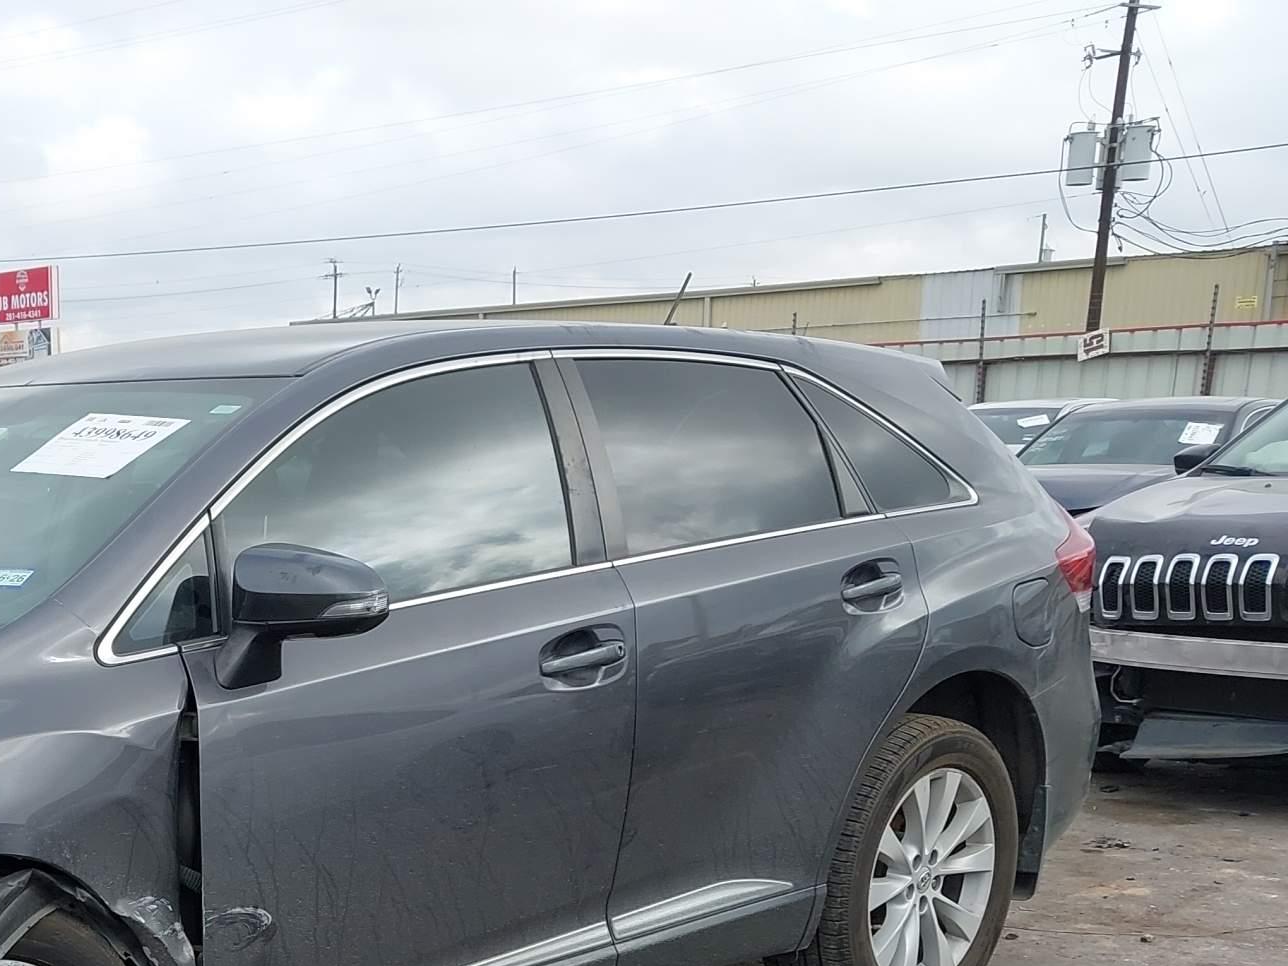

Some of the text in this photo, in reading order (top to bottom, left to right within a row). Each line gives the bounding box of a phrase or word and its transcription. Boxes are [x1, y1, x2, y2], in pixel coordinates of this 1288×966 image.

[11, 291, 48, 309] MOTORS
[72, 425, 157, 441] 43998649
[1210, 535, 1259, 548] Jeep
